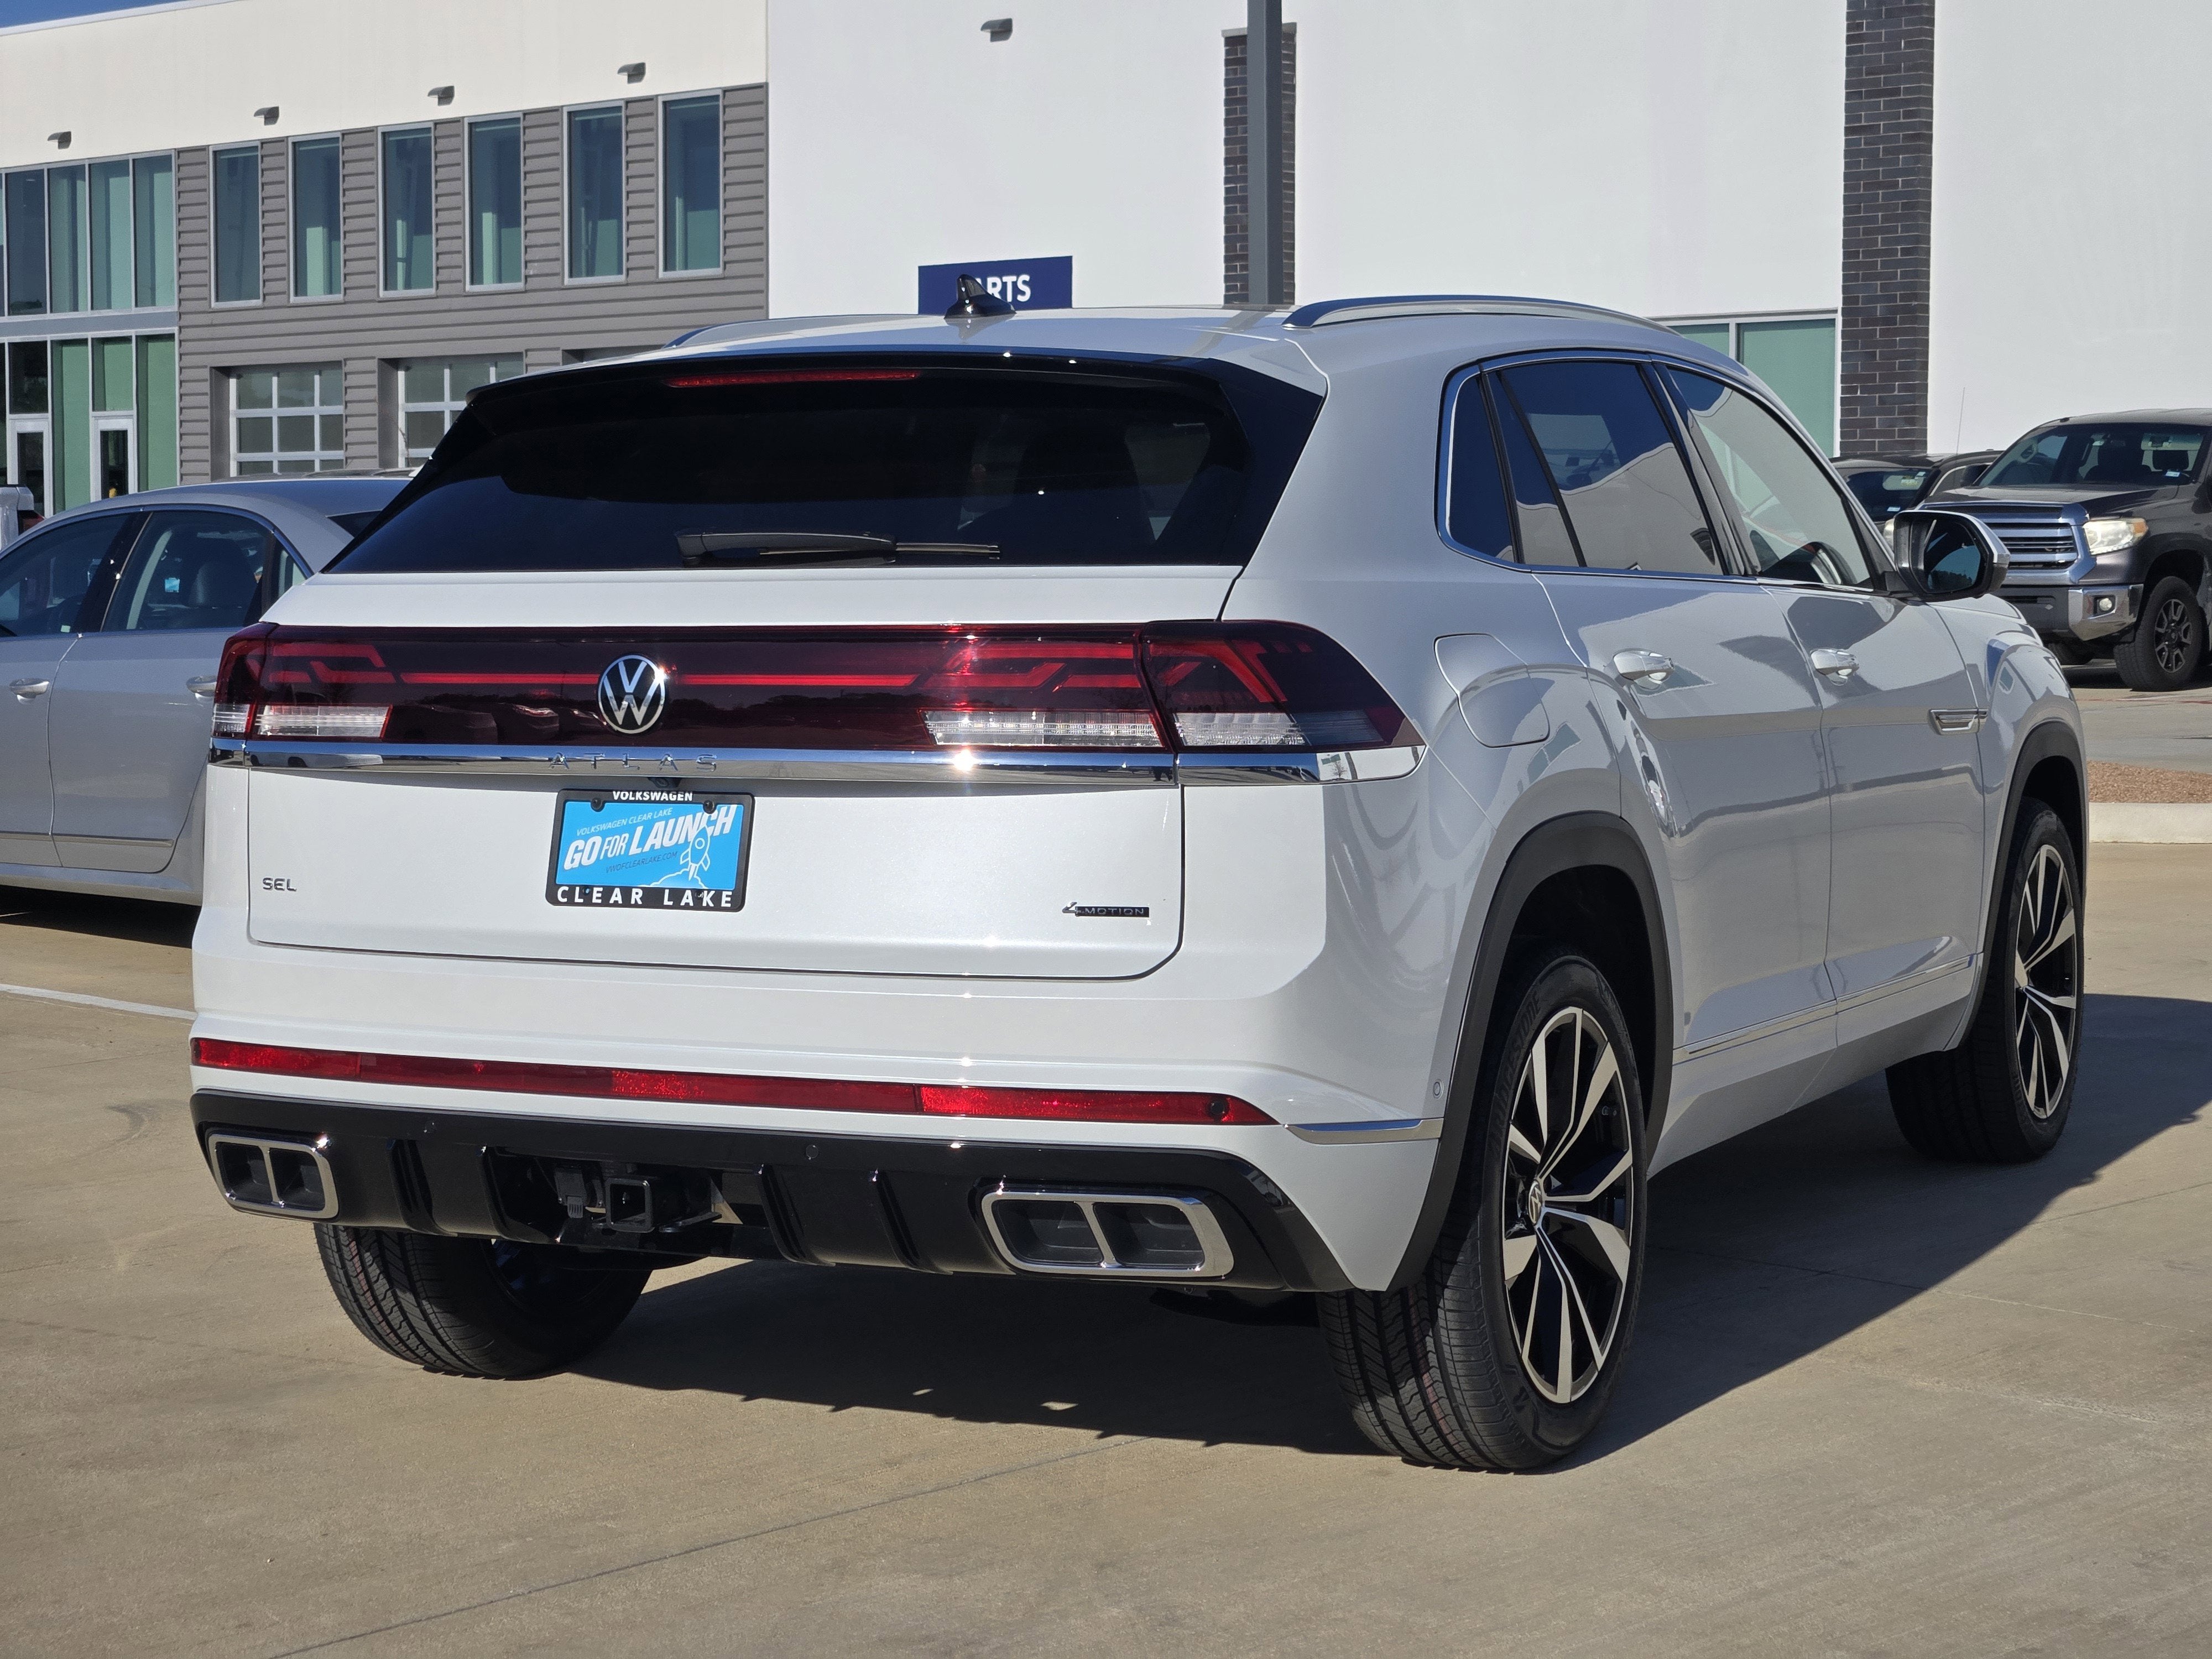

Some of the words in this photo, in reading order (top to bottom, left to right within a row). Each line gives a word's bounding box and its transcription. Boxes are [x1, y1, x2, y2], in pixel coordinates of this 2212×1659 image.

[974, 275, 1031, 302] RTS
[601, 658, 662, 727] VW
[549, 752, 717, 772] ATLAS
[612, 791, 693, 801] VOLKSWAGEN
[577, 818, 628, 836] VOLKSWAGEN
[629, 812, 653, 824] CLEAR
[653, 807, 673, 818] LAKE
[564, 836, 602, 870] GO
[599, 833, 629, 860] FOR
[629, 805, 737, 855] LAUNCH
[606, 852, 679, 873] VWOFCLEARLAKE.COM
[262, 877, 297, 891] SEL
[557, 886, 643, 905] CLEAR
[663, 889, 732, 907] LAKE
